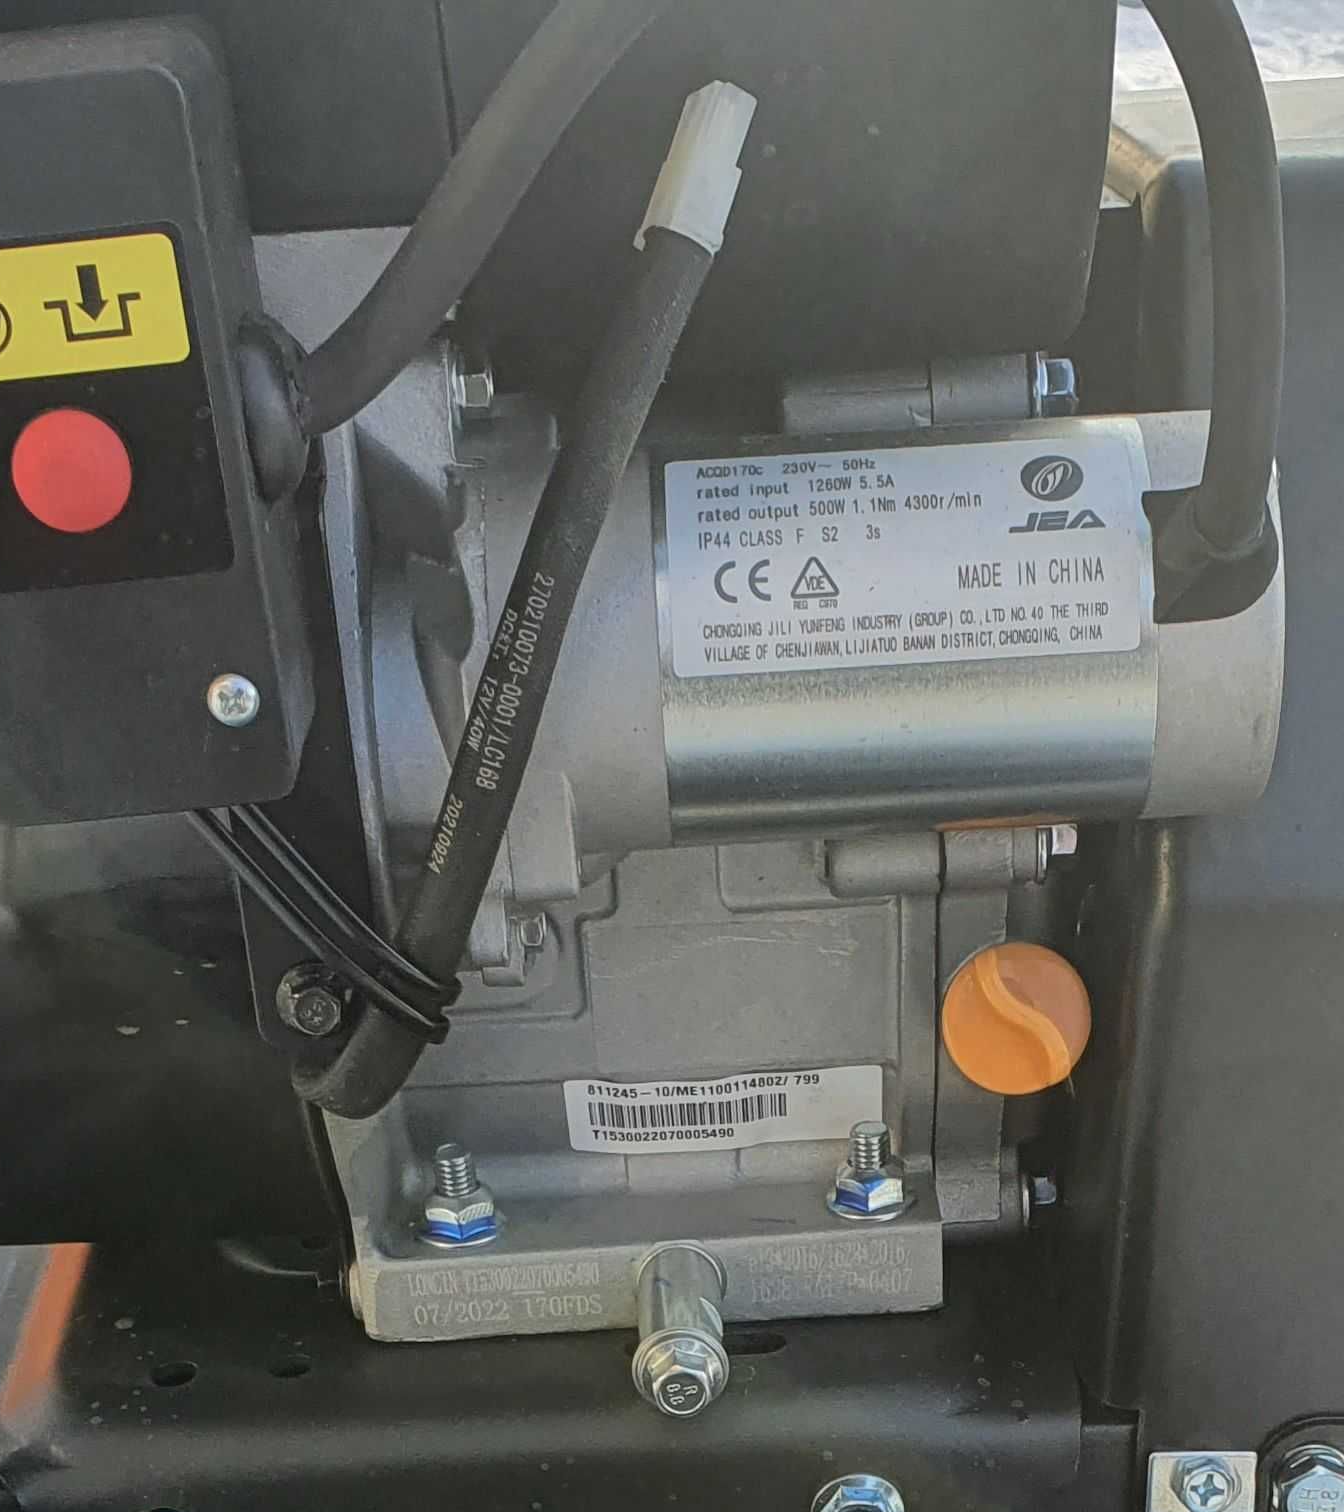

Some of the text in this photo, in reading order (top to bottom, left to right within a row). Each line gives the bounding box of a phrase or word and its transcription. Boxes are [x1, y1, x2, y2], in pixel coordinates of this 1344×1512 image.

[696, 485, 739, 499] rated
[750, 482, 790, 499] input
[808, 476, 852, 493] 1260W
[697, 508, 741, 524] rated
[748, 503, 800, 522] output
[809, 500, 845, 517] 500W
[904, 492, 982, 511] 4300r/min
[1008, 509, 1106, 534] JEA
[699, 524, 881, 550] IP44 CLASS F S2 3s
[713, 559, 772, 603] CE
[804, 576, 825, 591] VDE
[958, 557, 1105, 590] MADE IN CHINA
[703, 622, 762, 639] CHONGQING
[768, 620, 791, 637] JILI
[800, 617, 846, 635] YUNFENG
[852, 614, 903, 631] INDUSTRY
[909, 611, 953, 630] (GROUP)
[1031, 606, 1044, 620] 40
[1051, 604, 1069, 619] THE
[1076, 601, 1109, 617] THIRD
[704, 645, 750, 663] VILLAGE
[756, 645, 768, 660] OF
[903, 634, 936, 651] BANAN
[1070, 624, 1103, 641] CHINA
